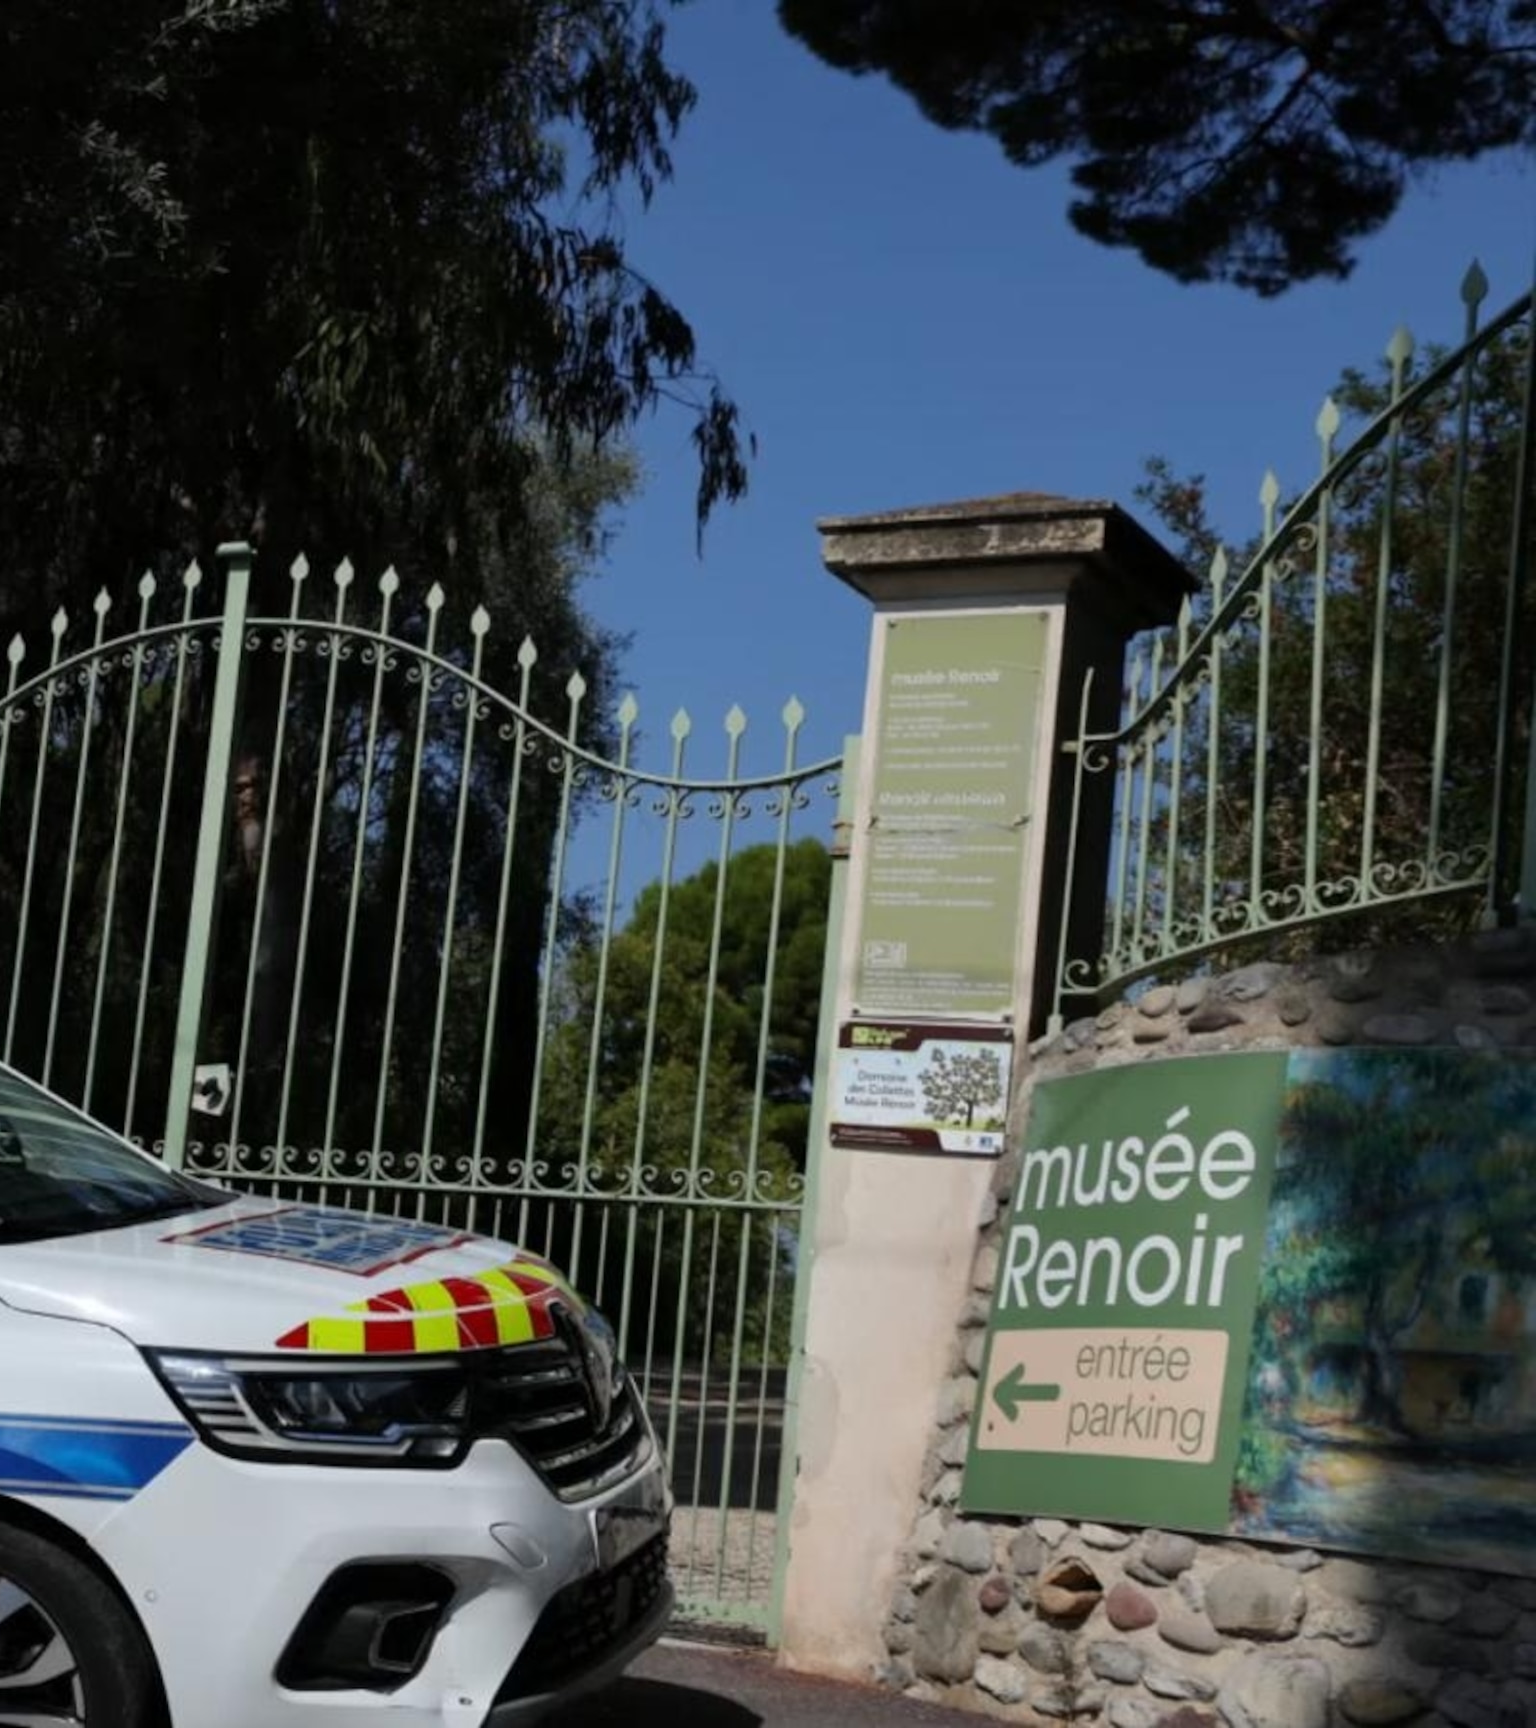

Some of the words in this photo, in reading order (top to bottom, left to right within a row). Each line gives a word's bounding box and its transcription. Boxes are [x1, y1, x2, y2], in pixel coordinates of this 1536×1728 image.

[1015, 1106, 1256, 1212] musée
[998, 1213, 1244, 1310] Renoir
[1075, 1333, 1191, 1383] entrée
[1065, 1399, 1206, 1456] parking
